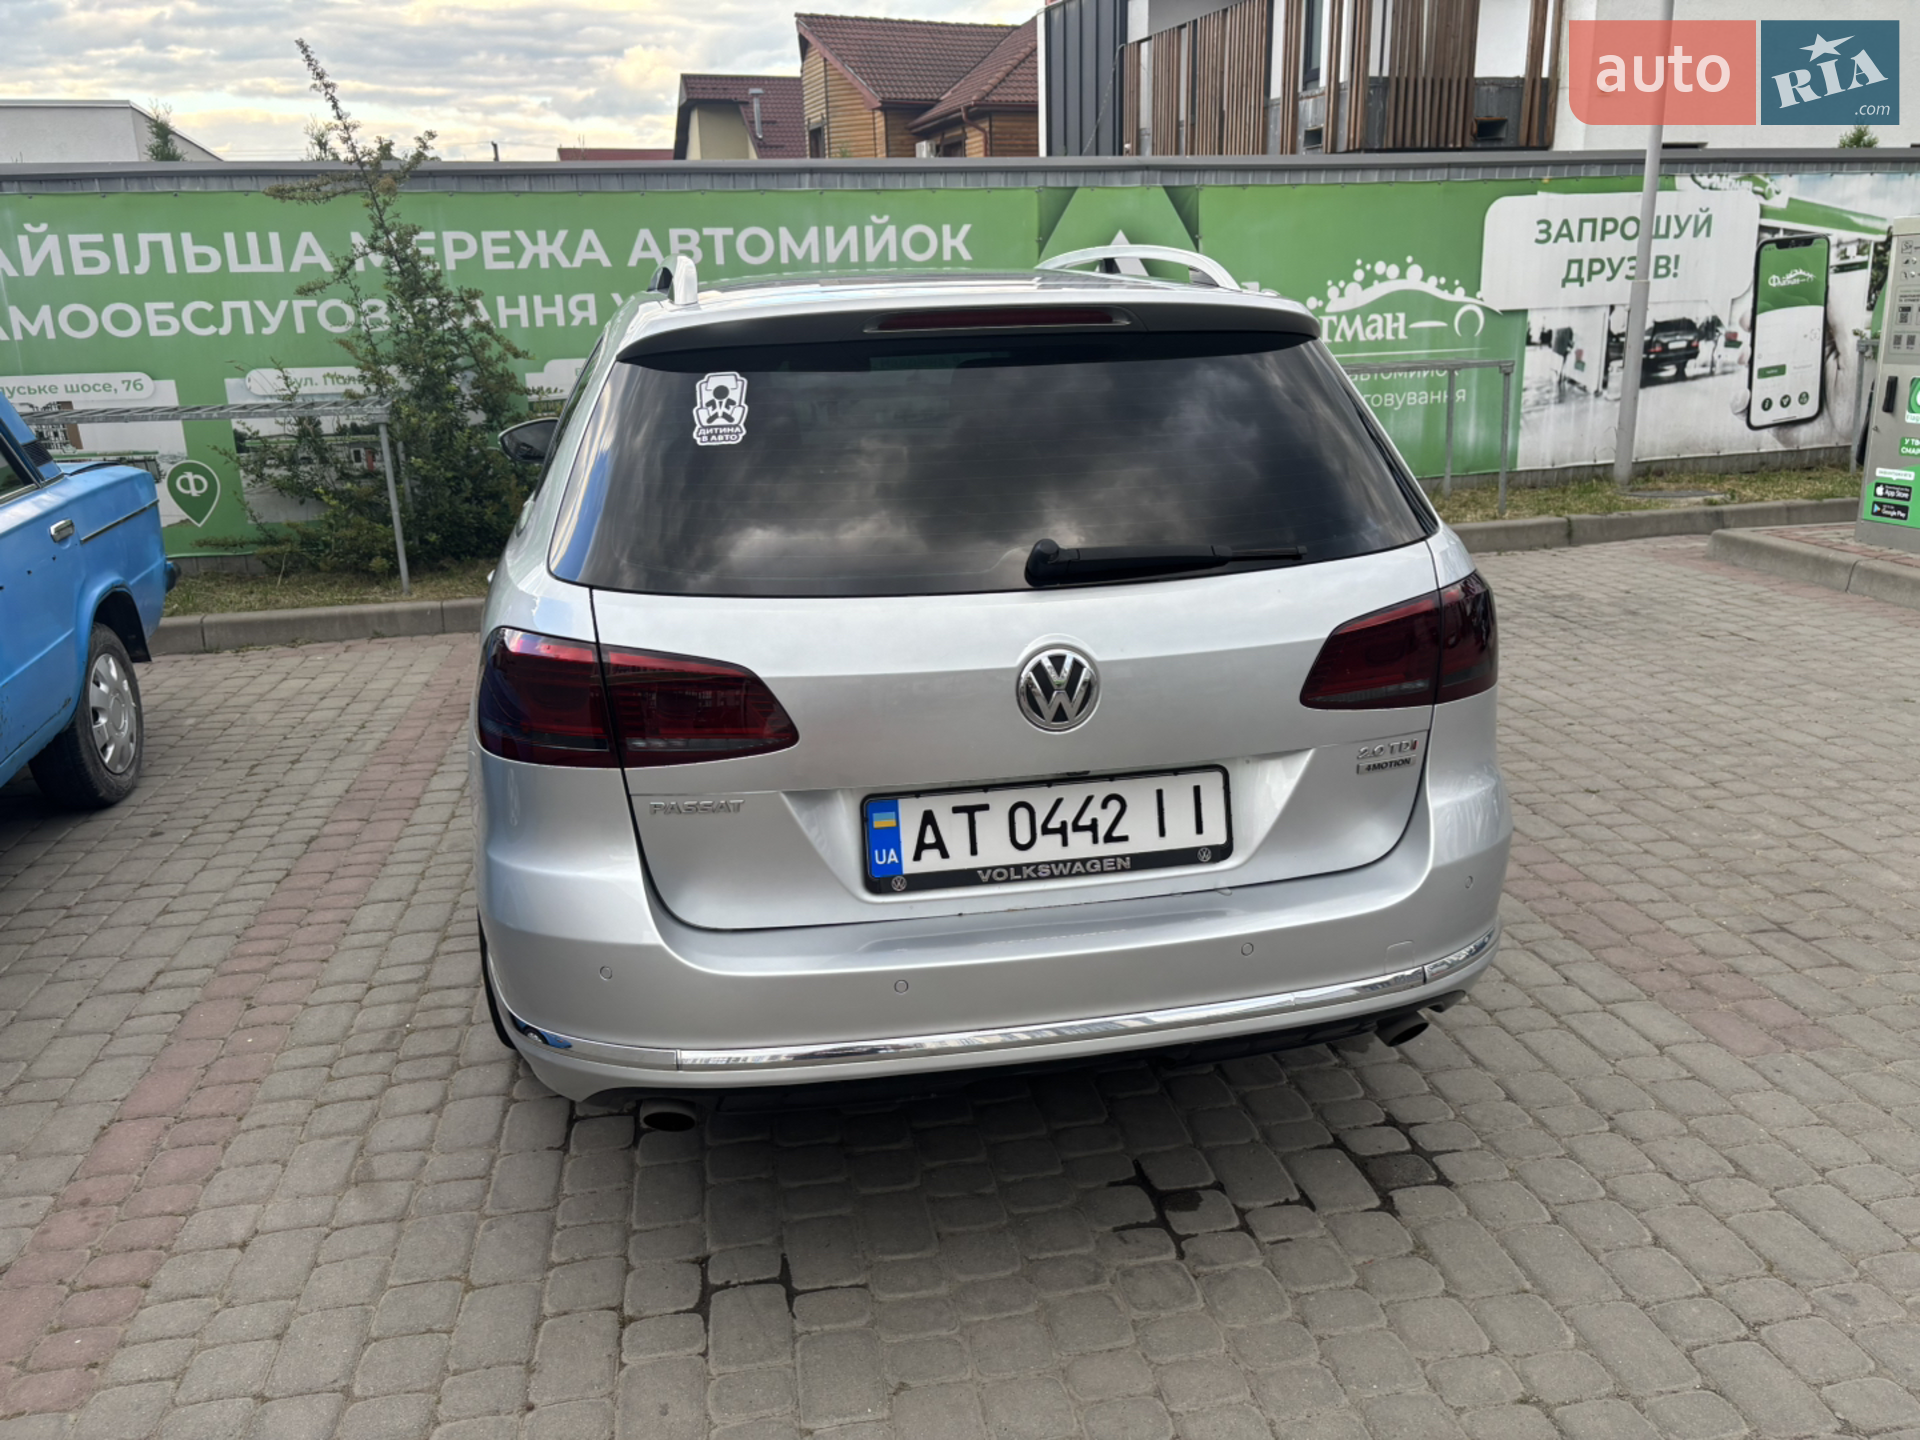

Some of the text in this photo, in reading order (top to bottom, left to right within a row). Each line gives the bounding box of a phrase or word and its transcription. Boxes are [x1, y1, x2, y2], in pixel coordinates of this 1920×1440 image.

[1534, 207, 1713, 245] ЗАПРОШУЙ
[627, 214, 973, 267] АВТОМИЙОК
[1561, 254, 1680, 289] ДРУЗВ!
[64, 382, 118, 395] шосе,
[698, 427, 741, 436] ДИТИНА
[710, 434, 738, 442] АВТО
[1357, 738, 1419, 760] 2.0 TDI
[1365, 757, 1412, 772] 4MOTION
[649, 798, 745, 815] PASSAT
[1008, 793, 1129, 851] 0442
[874, 848, 899, 865] UA
[977, 857, 1131, 882] VOLKSWAGEN
